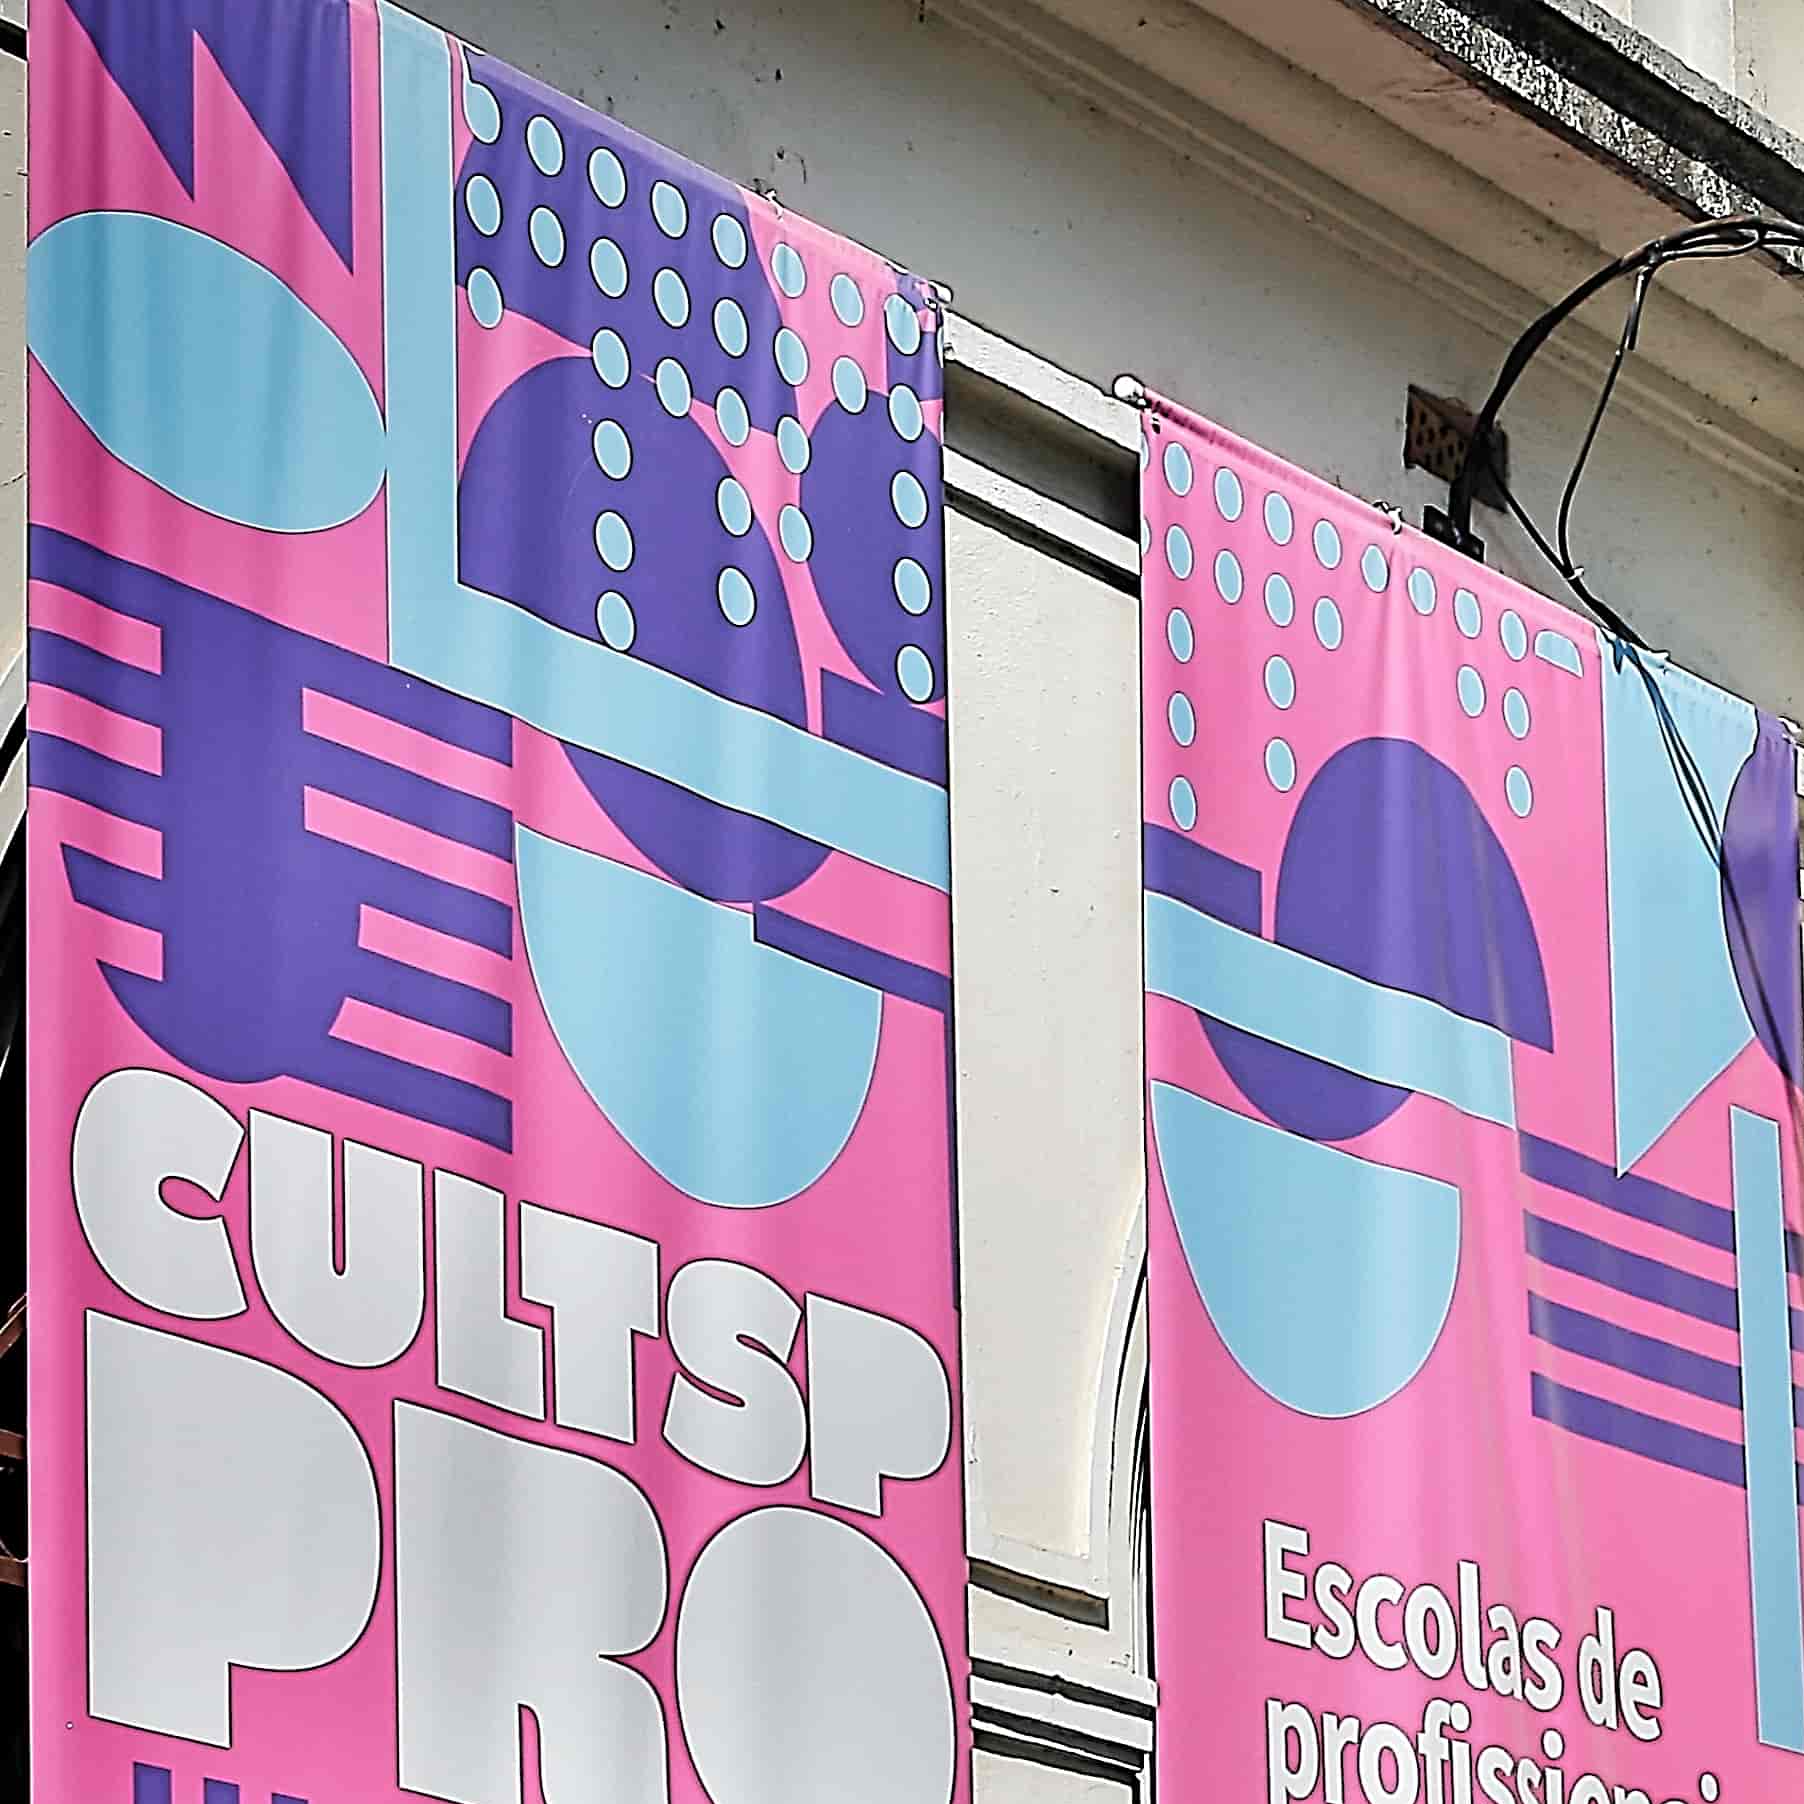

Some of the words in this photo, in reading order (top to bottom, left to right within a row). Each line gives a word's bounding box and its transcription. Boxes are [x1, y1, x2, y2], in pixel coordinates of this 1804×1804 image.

[72, 1067, 952, 1518] CULTSP
[1264, 1519, 1562, 1714] Escolas
[1579, 1606, 1661, 1740] de
